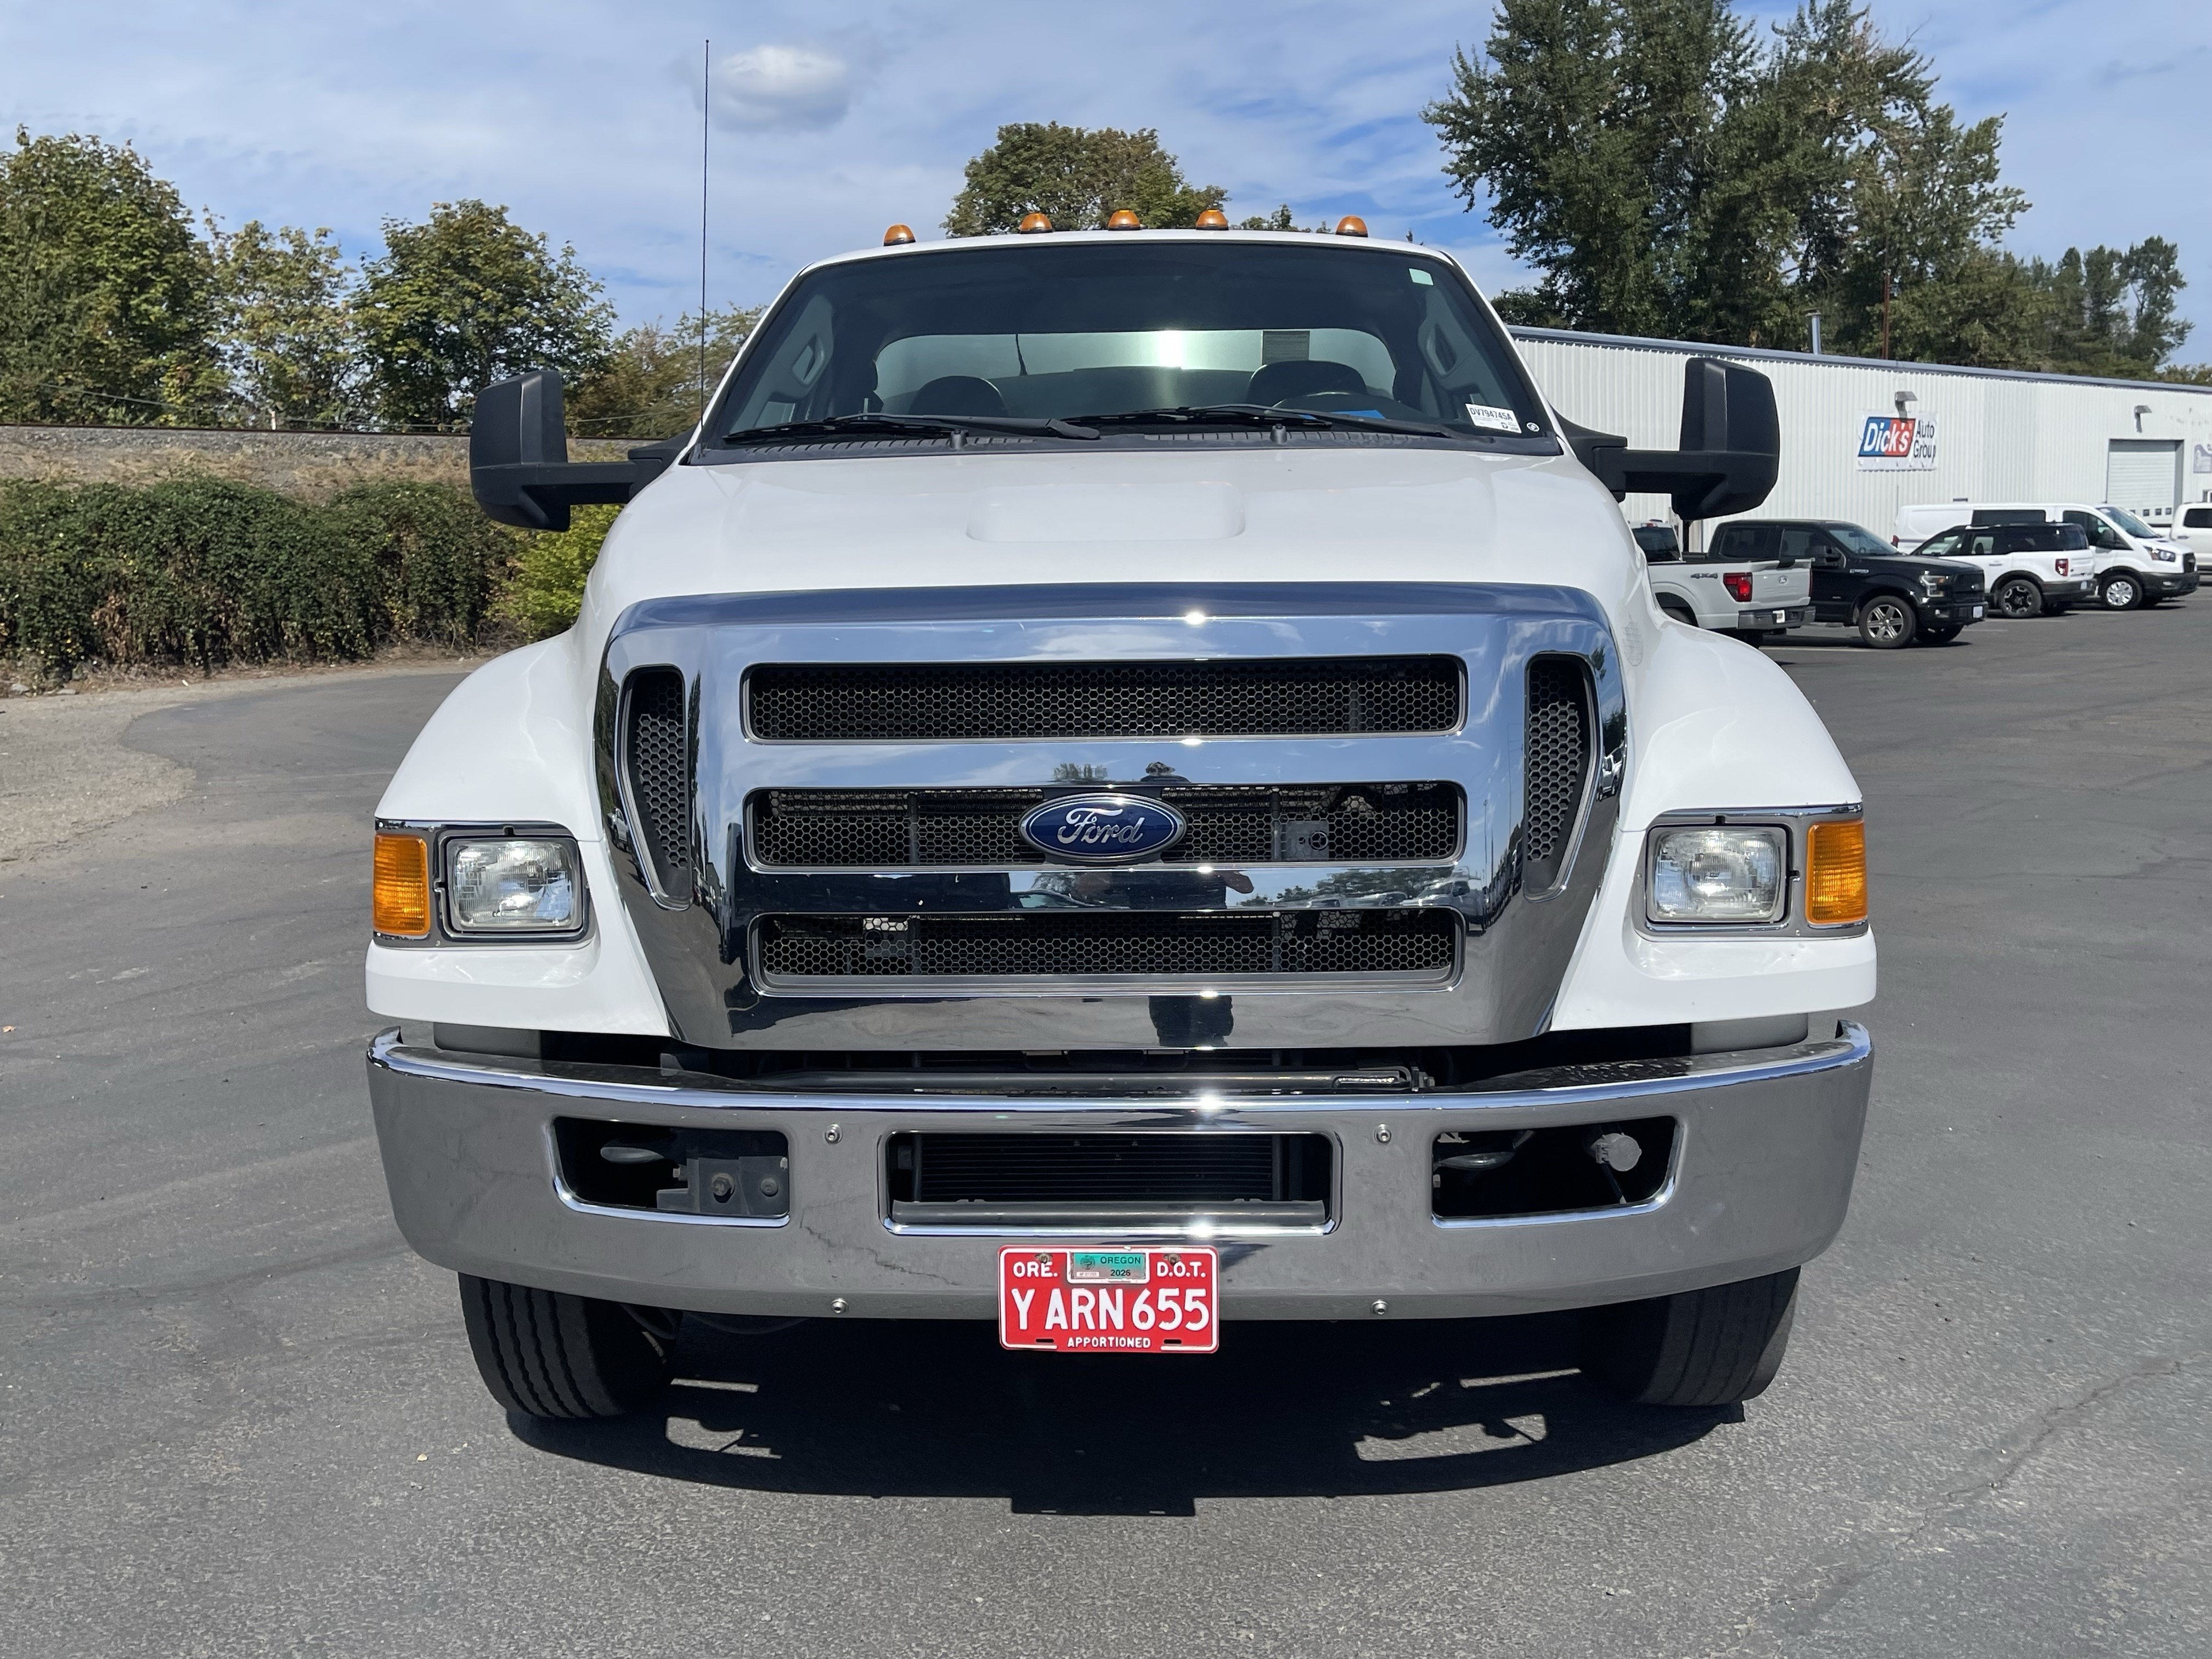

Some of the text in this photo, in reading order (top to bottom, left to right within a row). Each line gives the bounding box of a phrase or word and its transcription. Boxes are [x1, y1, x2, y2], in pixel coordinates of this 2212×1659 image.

[1470, 408, 1513, 421] DV794745A
[1863, 422, 1910, 453] Dick's
[1915, 420, 1935, 438] Auto
[1913, 440, 1937, 463] Group
[1057, 807, 1146, 844] Ford
[1013, 1261, 1206, 1278] ORE. D.O.T.
[1067, 1336, 1151, 1348] APPORTIONED
